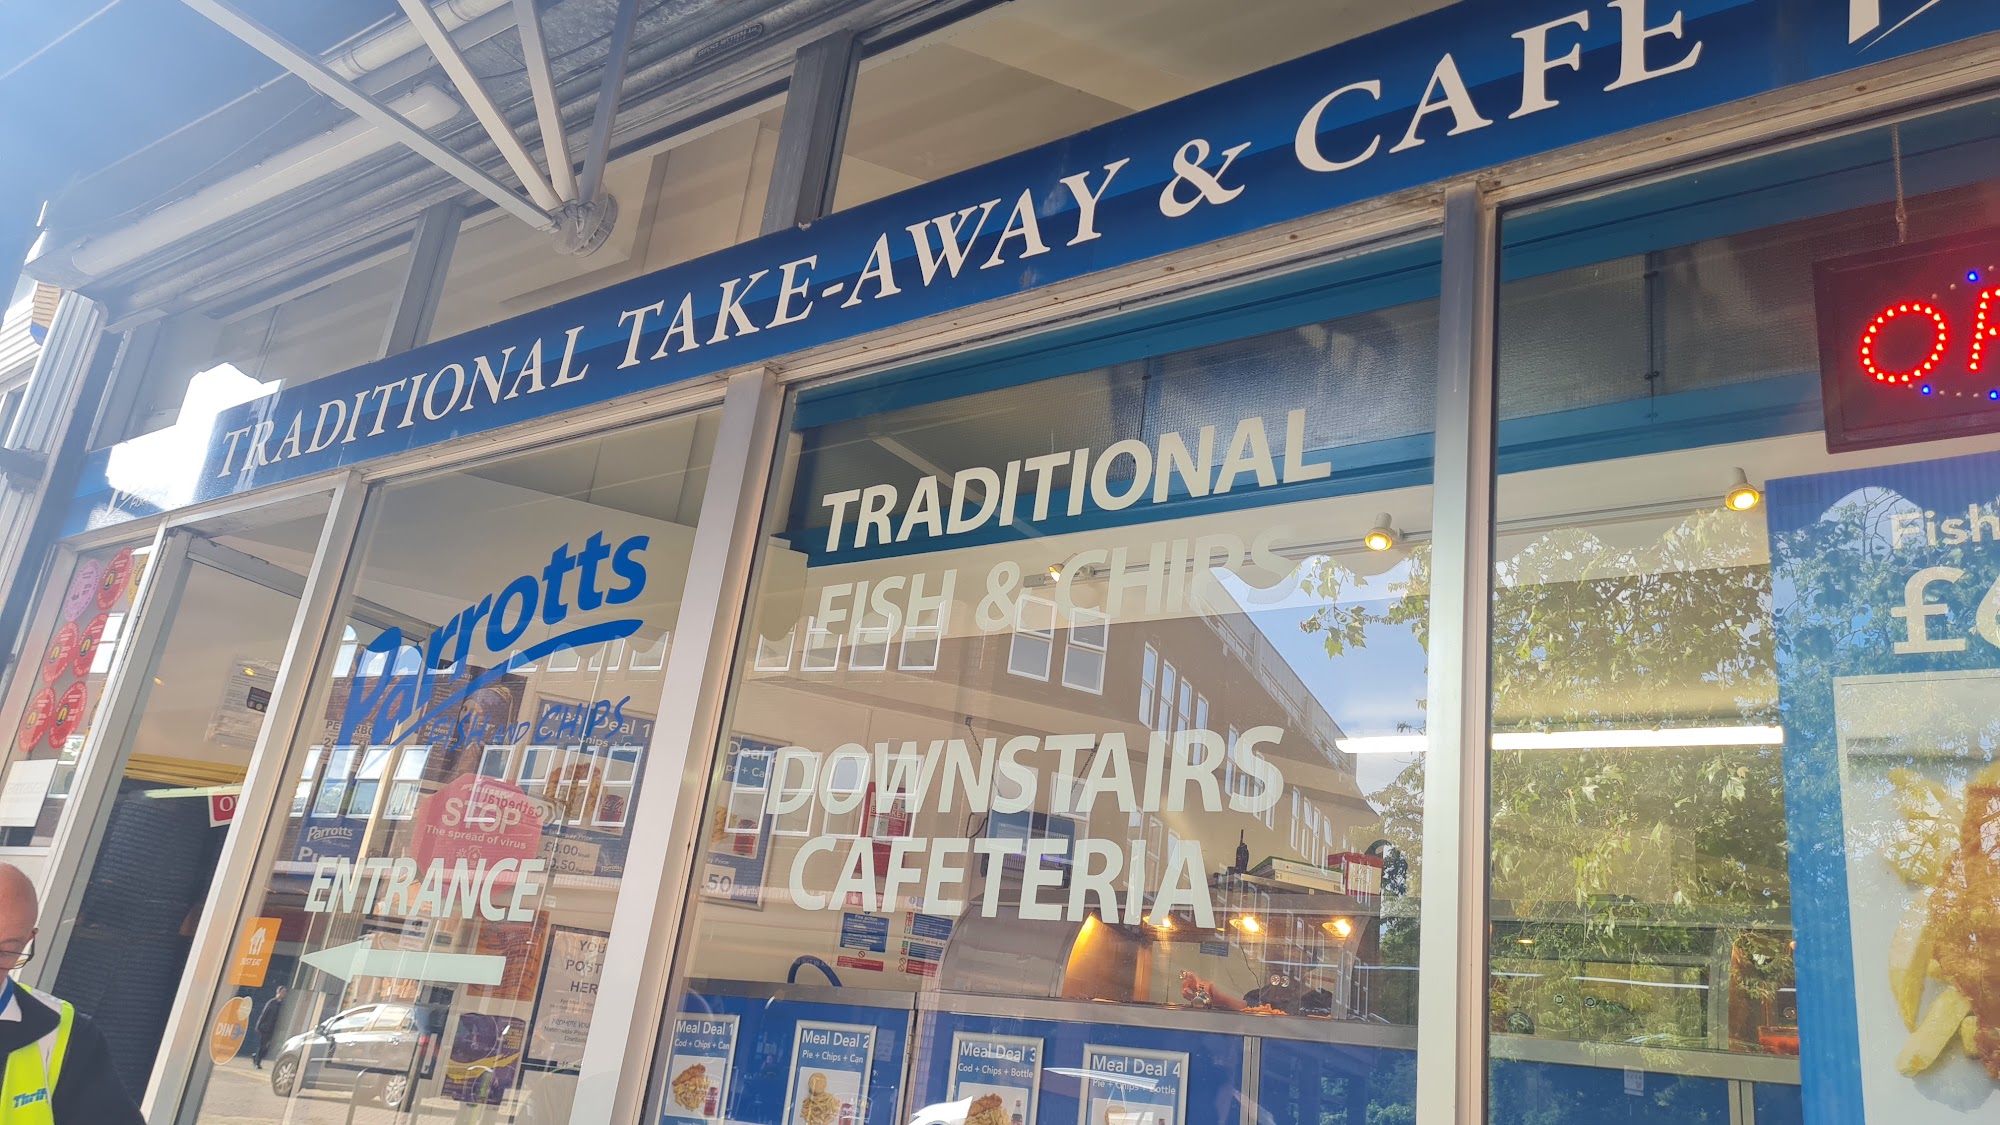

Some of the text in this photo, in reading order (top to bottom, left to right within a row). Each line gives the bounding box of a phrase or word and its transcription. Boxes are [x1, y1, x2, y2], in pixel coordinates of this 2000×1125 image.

[216, 0, 1704, 478] TRADITIONAL TAKE-AWAY & CAFE
[821, 408, 1332, 553] TRADITIONAL
[1889, 503, 2000, 550] Fish
[812, 526, 1303, 649] FISH & CHIPS
[334, 530, 650, 764] Parrotts
[534, 695, 632, 743] CHIPS
[766, 725, 1286, 816] DOWNSTAIRS
[306, 826, 353, 842] Parrotts
[441, 797, 522, 834] STOP
[426, 825, 527, 849] The spread of virus
[304, 856, 546, 922] ENTRANCE
[788, 836, 1217, 929] CAFETERIA
[674, 1038, 687, 1047] Cod
[694, 1040, 711, 1050] Chips
[718, 1041, 730, 1050] Can
[676, 1020, 701, 1034] Meal
[703, 1021, 726, 1036] Deal
[802, 1030, 870, 1048] Meal Deal 2
[802, 1049, 813, 1059] Pie
[821, 1051, 841, 1063] Chips
[849, 1054, 864, 1064] Can
[958, 1062, 973, 1072] Cod
[981, 1065, 1002, 1077] Chips
[1010, 1067, 1034, 1078] Bottle
[960, 1041, 1037, 1062] Meal Deal 3
[1092, 1054, 1181, 1078] Meal Deal 4
